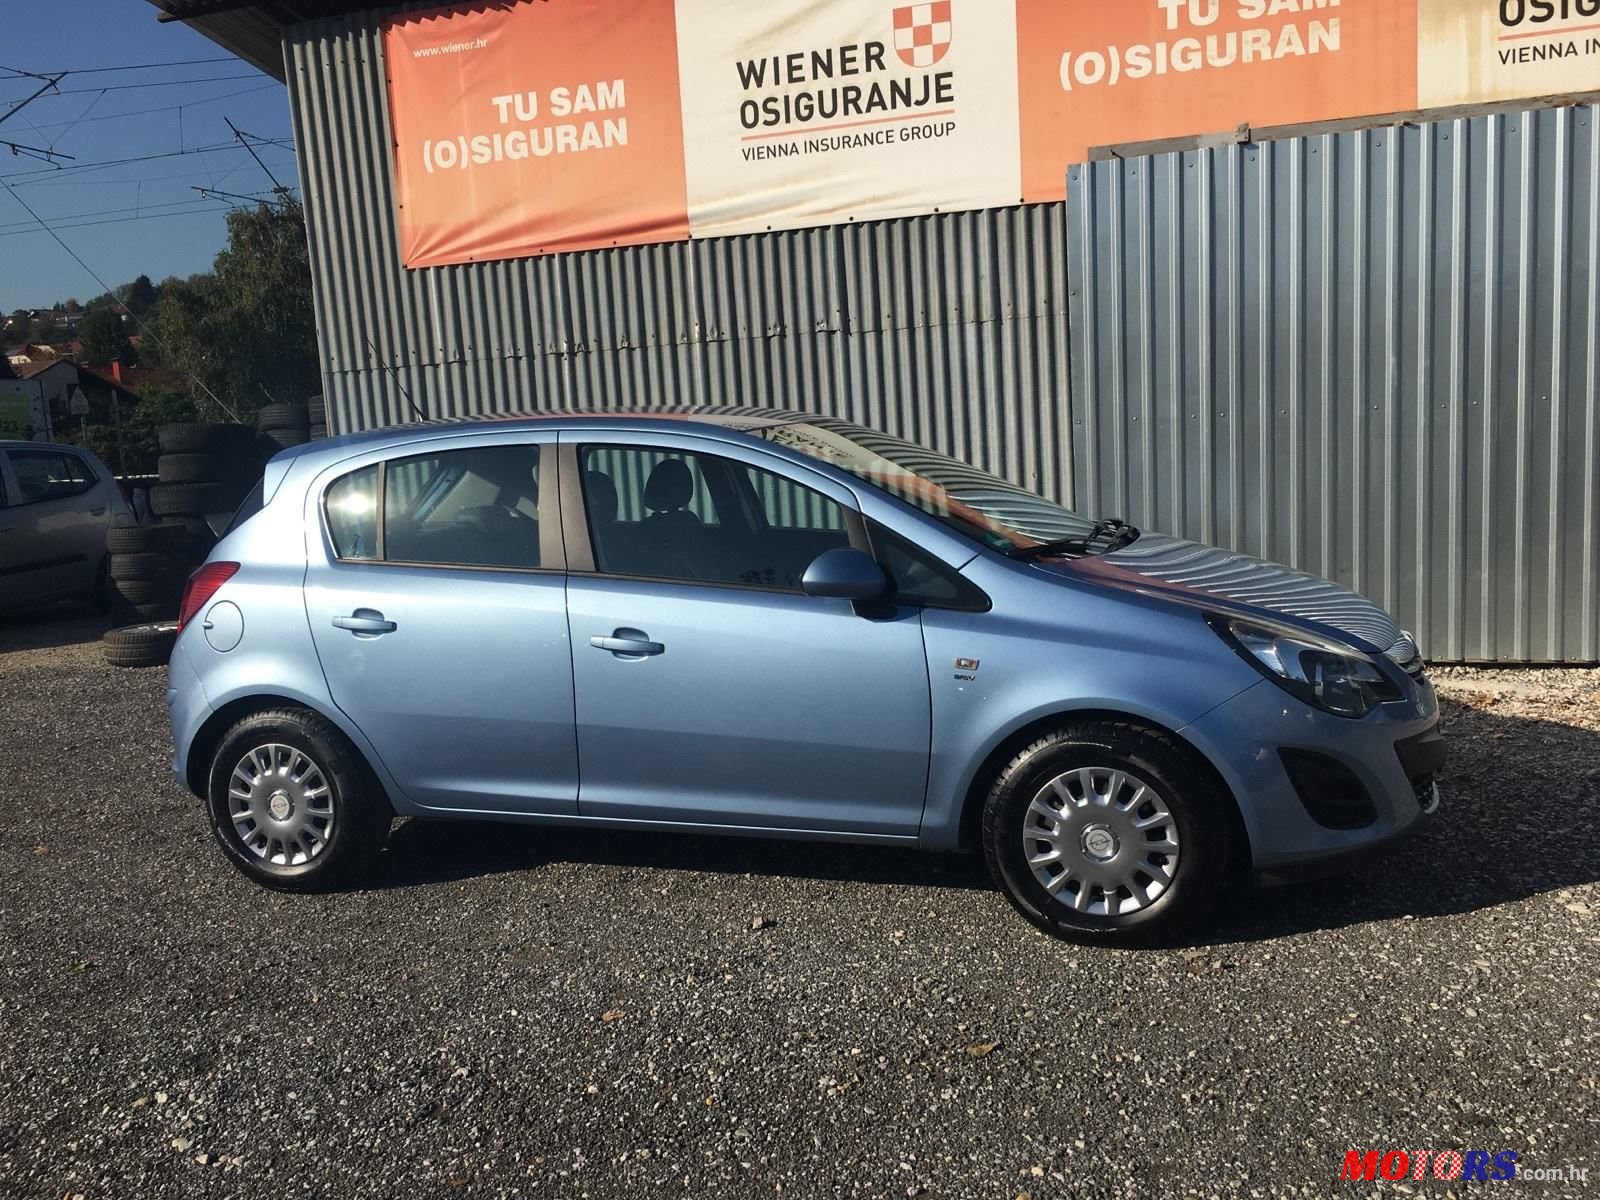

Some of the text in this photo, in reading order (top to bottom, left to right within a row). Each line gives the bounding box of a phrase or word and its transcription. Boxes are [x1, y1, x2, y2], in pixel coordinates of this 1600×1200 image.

[1157, 0, 1219, 30] TU
[413, 38, 488, 58] www.wiener.hr
[736, 41, 887, 90] WIENER
[1059, 18, 1341, 91] (O)SIGURAN
[1498, 41, 1578, 65] VIENNA
[492, 79, 626, 124] TU SAM
[740, 71, 955, 129] OSIGURANJE
[423, 118, 629, 173] (O)SIGURAN
[741, 121, 956, 162] VIENNA INSURANCE GROUP
